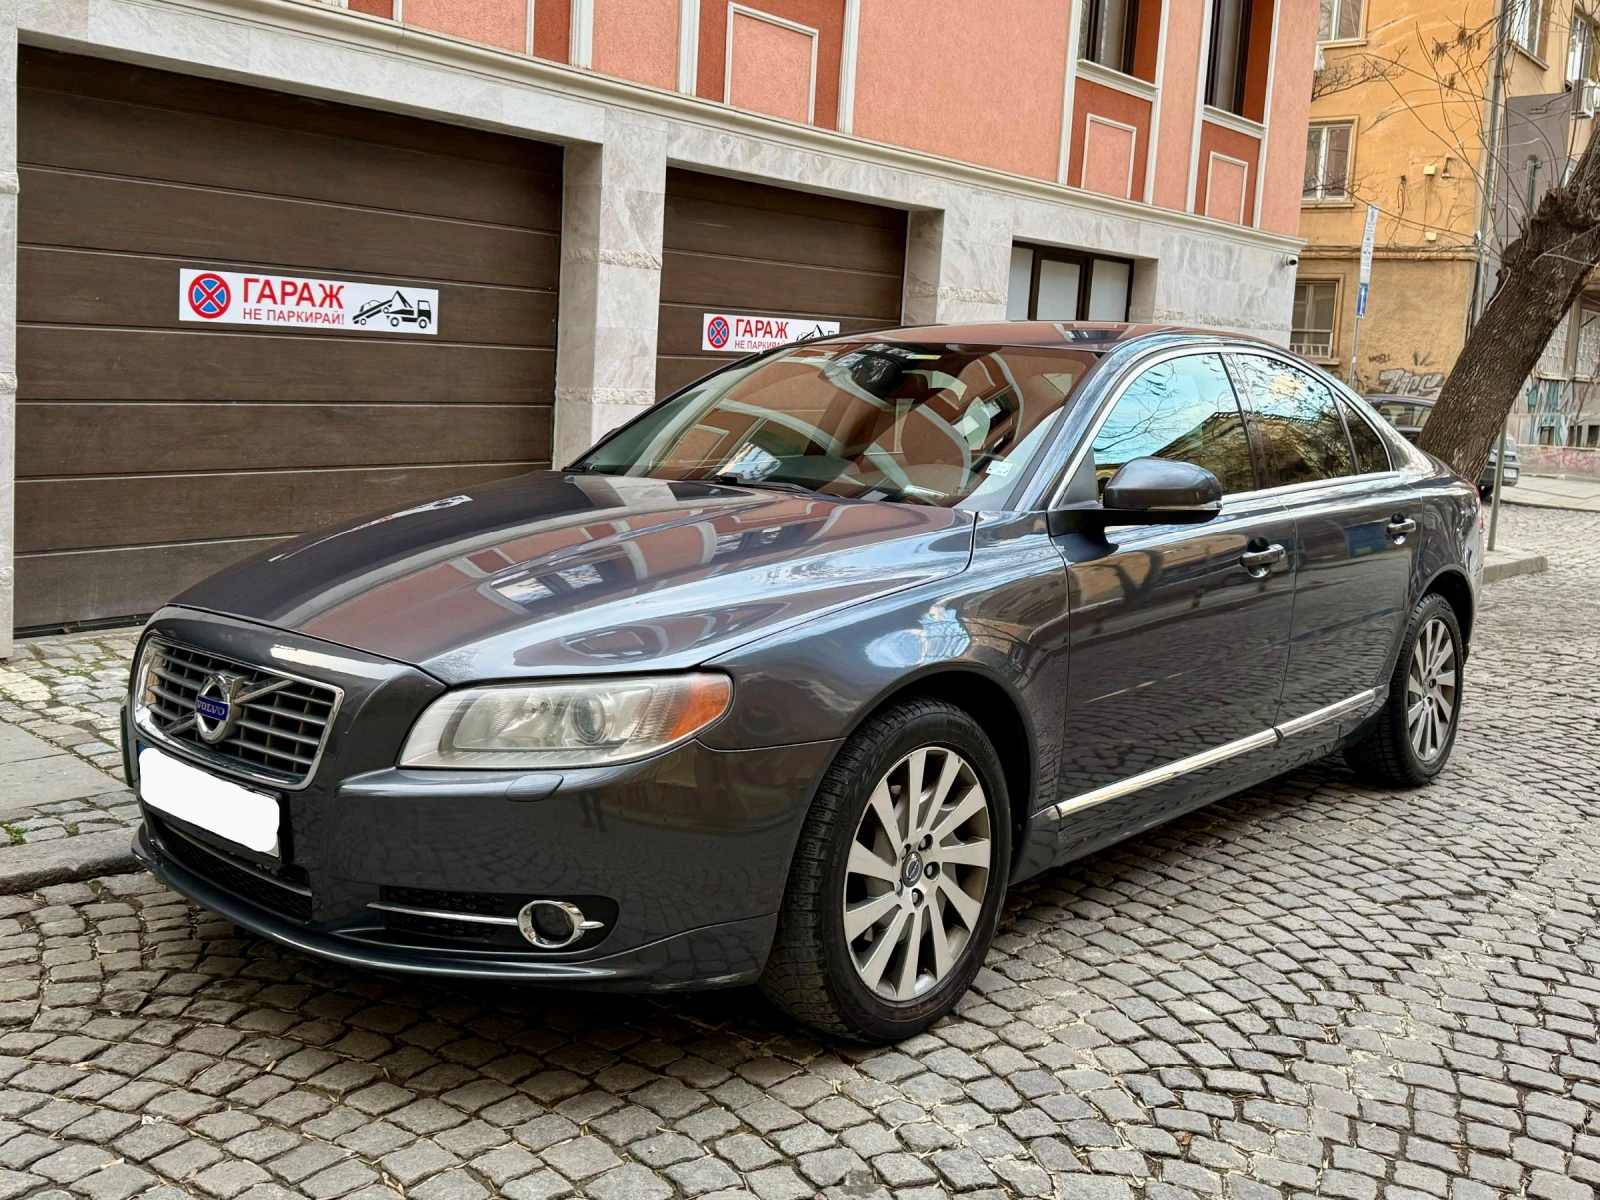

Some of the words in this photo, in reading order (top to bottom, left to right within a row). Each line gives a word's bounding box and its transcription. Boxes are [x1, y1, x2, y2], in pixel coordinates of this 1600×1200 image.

[243, 277, 345, 309] ГАРАЖ
[243, 308, 262, 321] НЕ
[267, 309, 345, 325] ПАРКИРАЙ!
[735, 319, 790, 339] ГАРАЖ
[735, 340, 745, 349] НЕ
[196, 700, 225, 716] VOLVO
